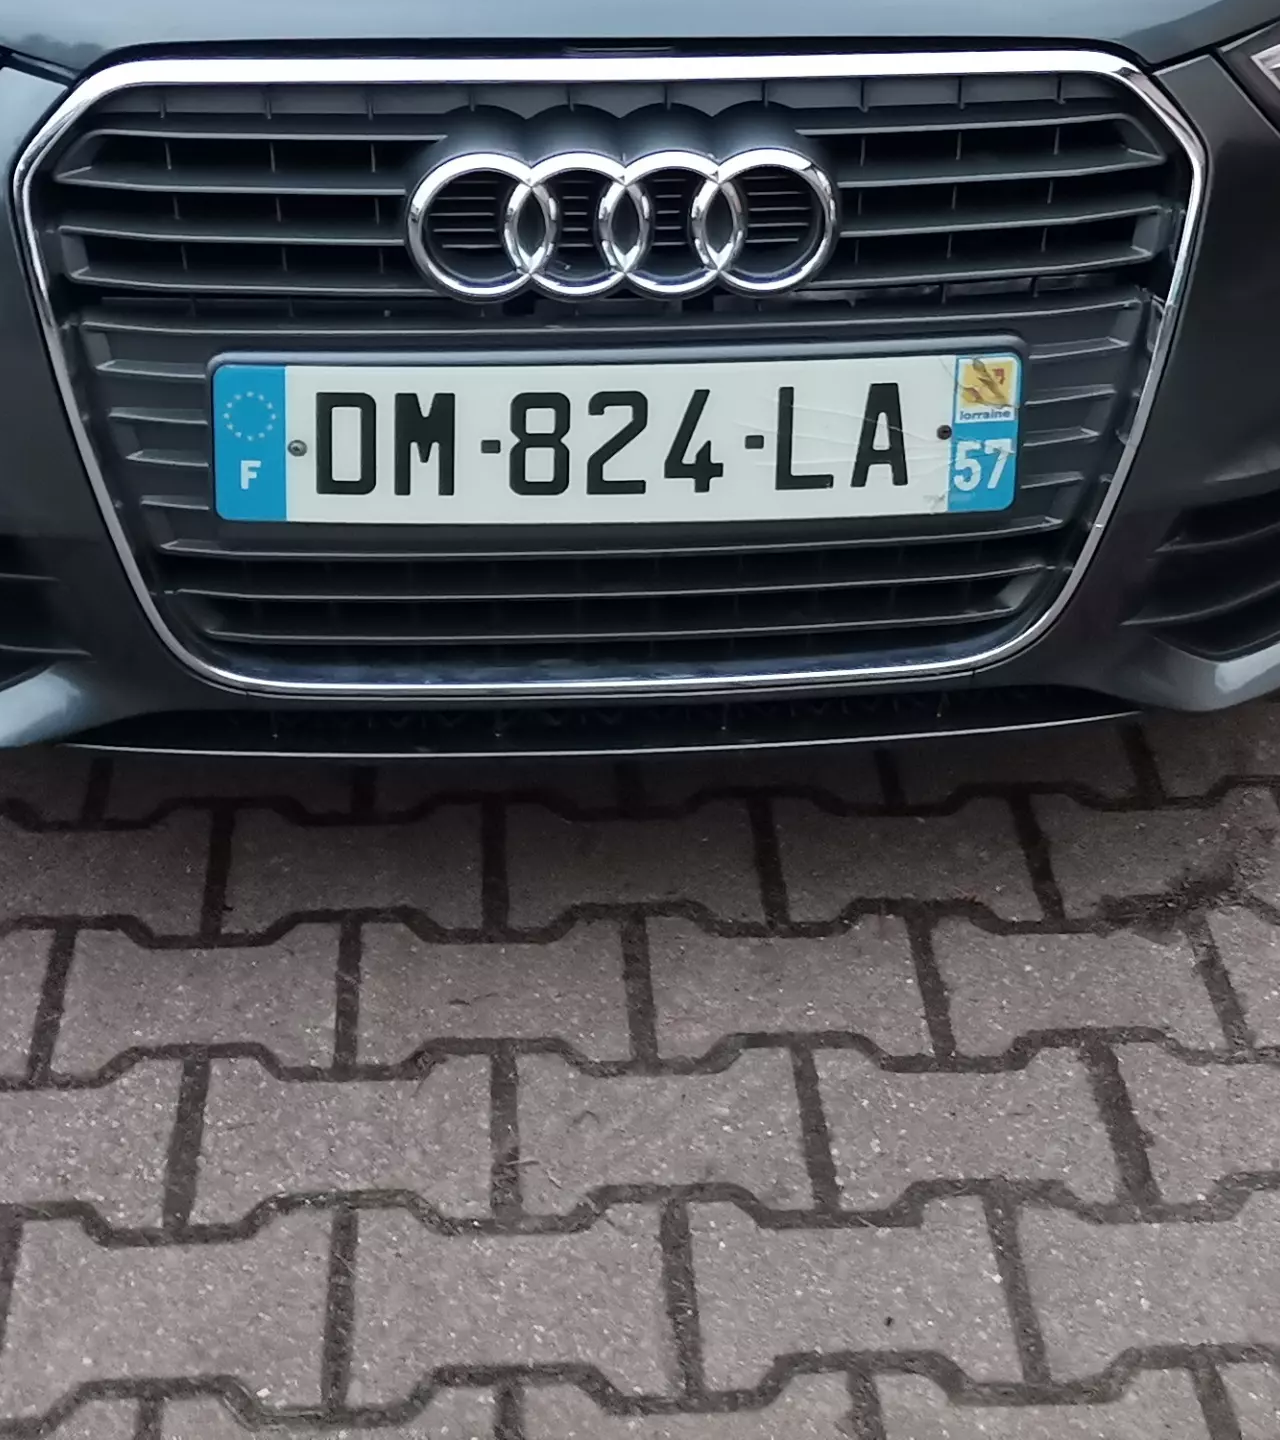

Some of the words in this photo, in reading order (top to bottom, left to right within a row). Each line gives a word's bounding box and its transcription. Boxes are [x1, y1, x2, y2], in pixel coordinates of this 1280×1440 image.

[314, 382, 910, 496] DM-824-LA
[953, 438, 1014, 491] 57
[240, 460, 262, 490] F
